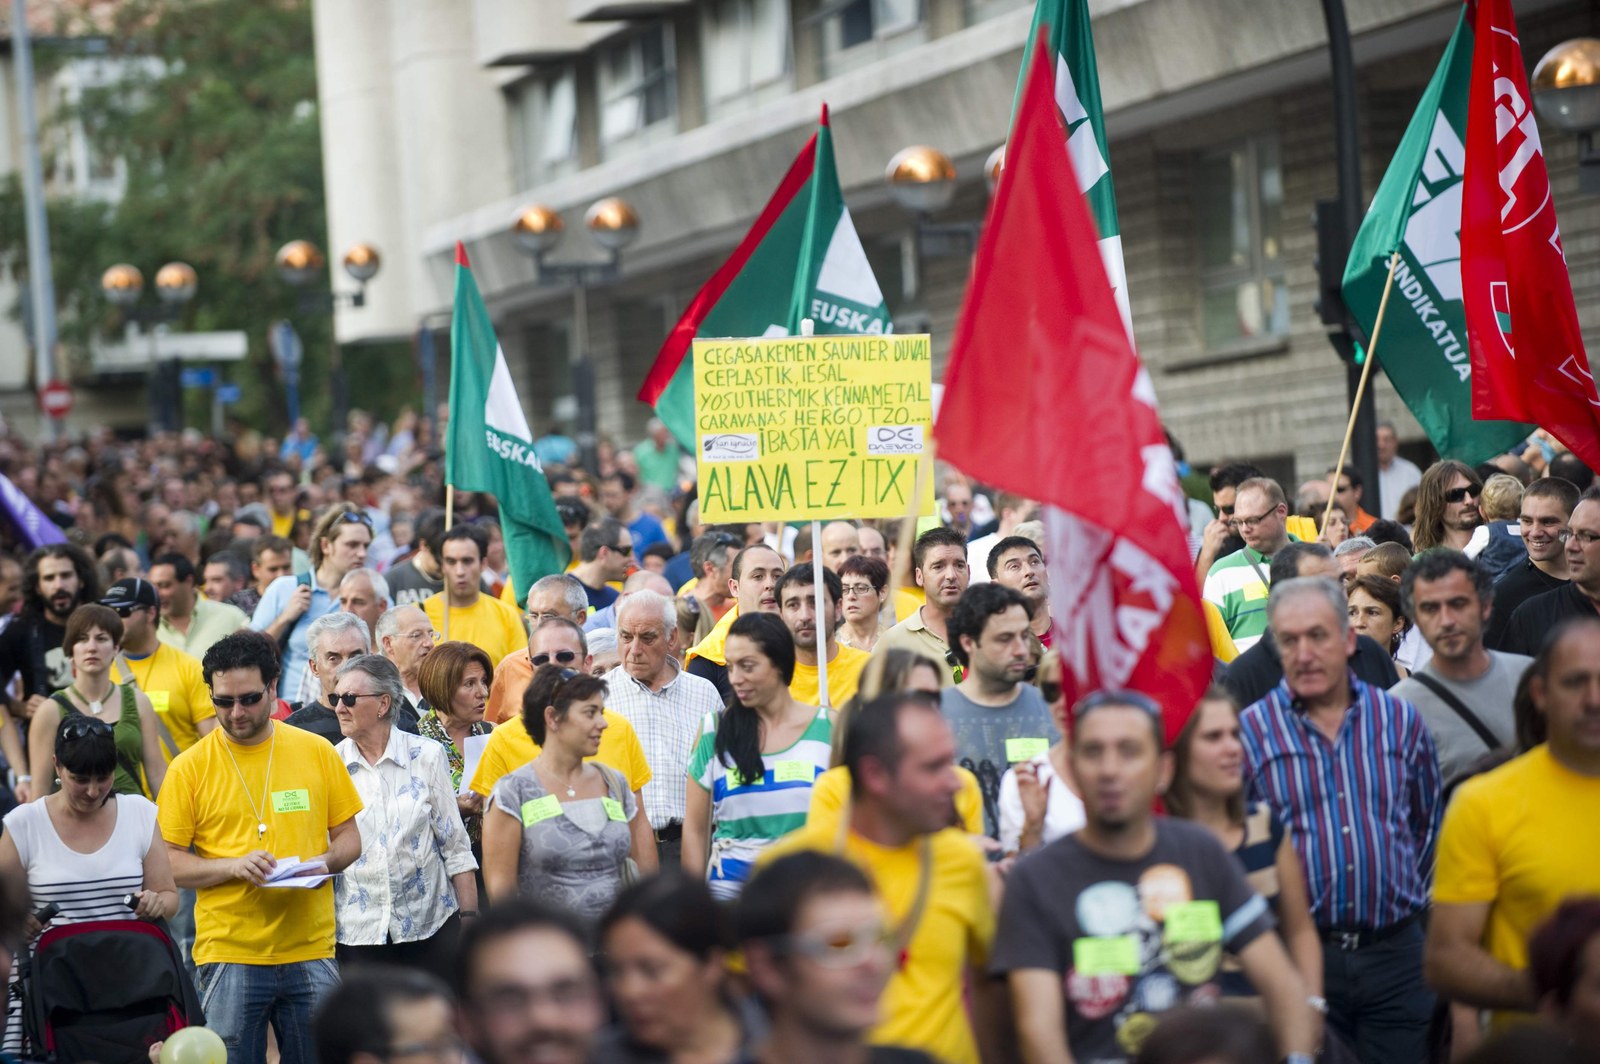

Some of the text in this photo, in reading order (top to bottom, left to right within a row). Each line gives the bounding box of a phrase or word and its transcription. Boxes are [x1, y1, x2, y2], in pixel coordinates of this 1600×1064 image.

[822, 341, 888, 362] SAUNIER
[894, 339, 931, 362] DUVAL
[699, 411, 786, 431] CARAVANAS
[702, 463, 797, 514] ALAVA
[805, 458, 849, 509] EZ
